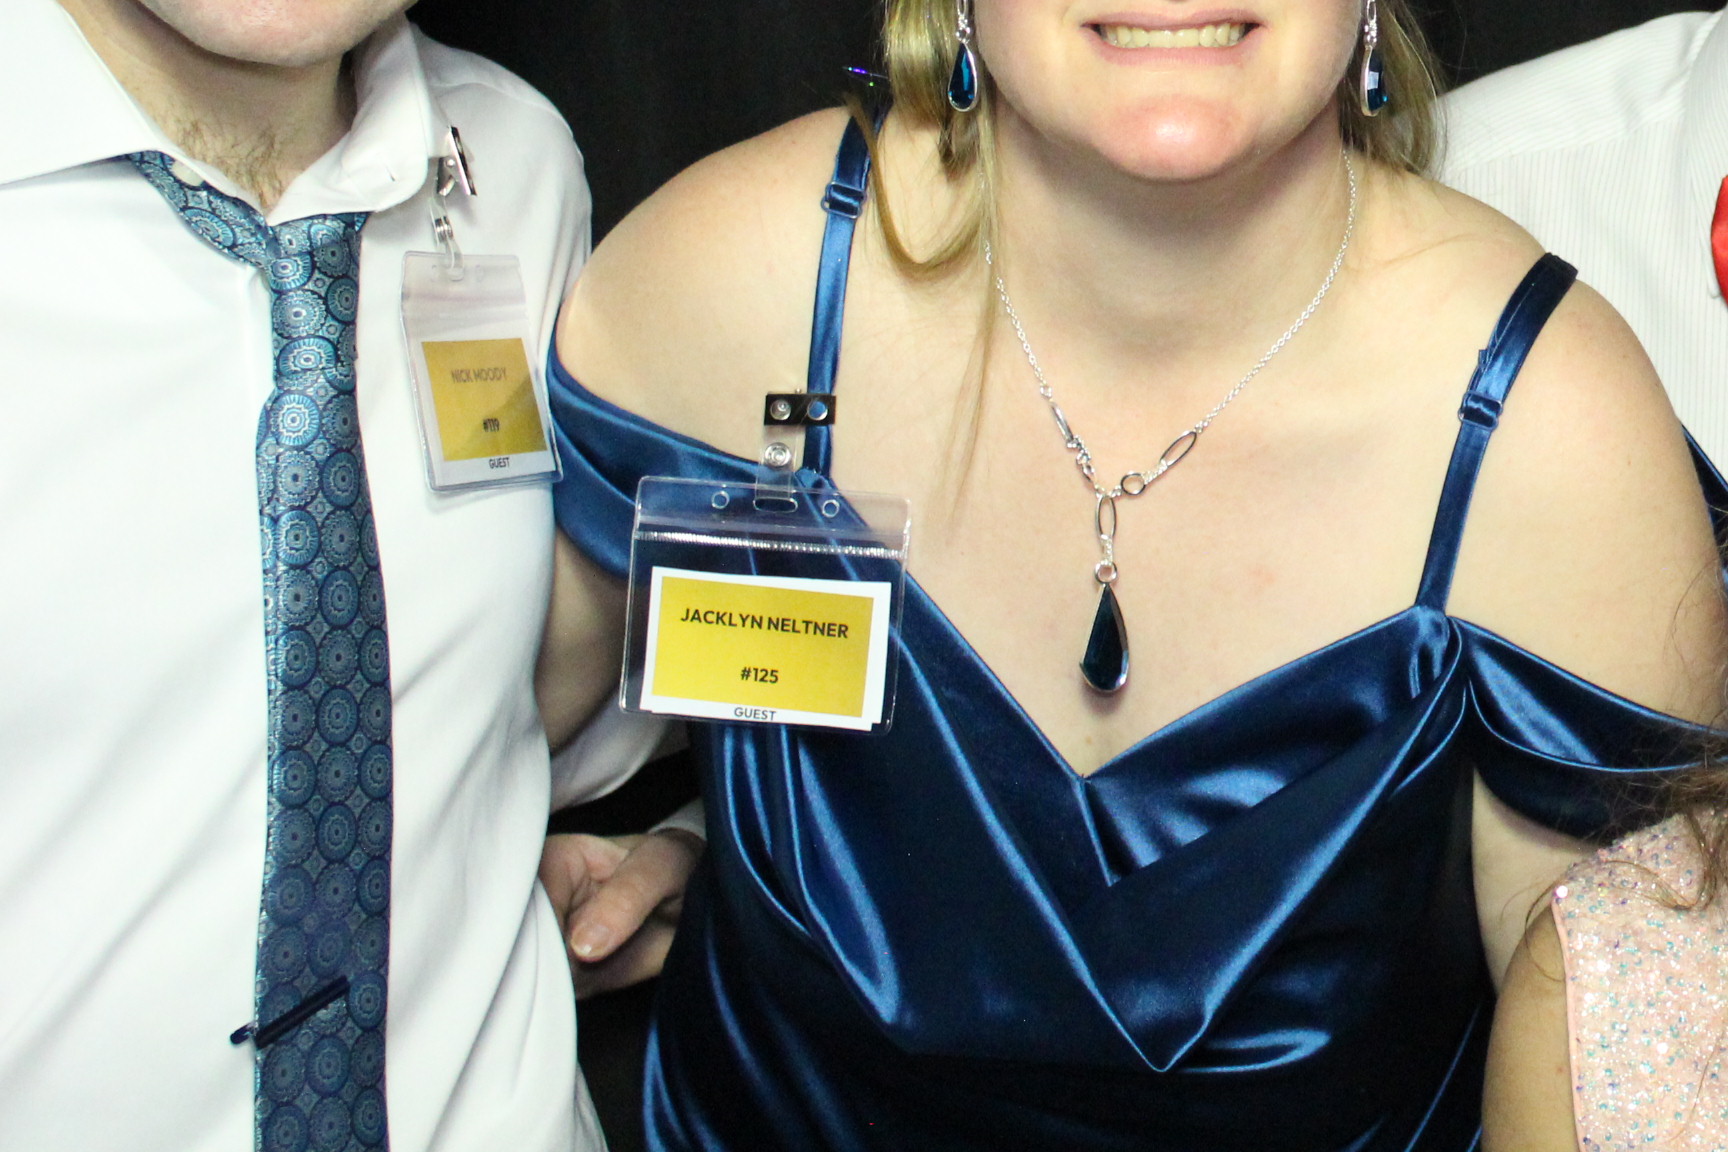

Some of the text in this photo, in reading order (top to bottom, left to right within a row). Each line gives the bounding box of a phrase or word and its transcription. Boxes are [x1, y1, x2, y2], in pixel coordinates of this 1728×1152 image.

[451, 367, 507, 384] NICK MOODY
[488, 456, 510, 470] GUEST
[680, 607, 849, 639] JACKLYN NELTNER
[740, 666, 779, 684] #125
[733, 706, 777, 722] GUEST
